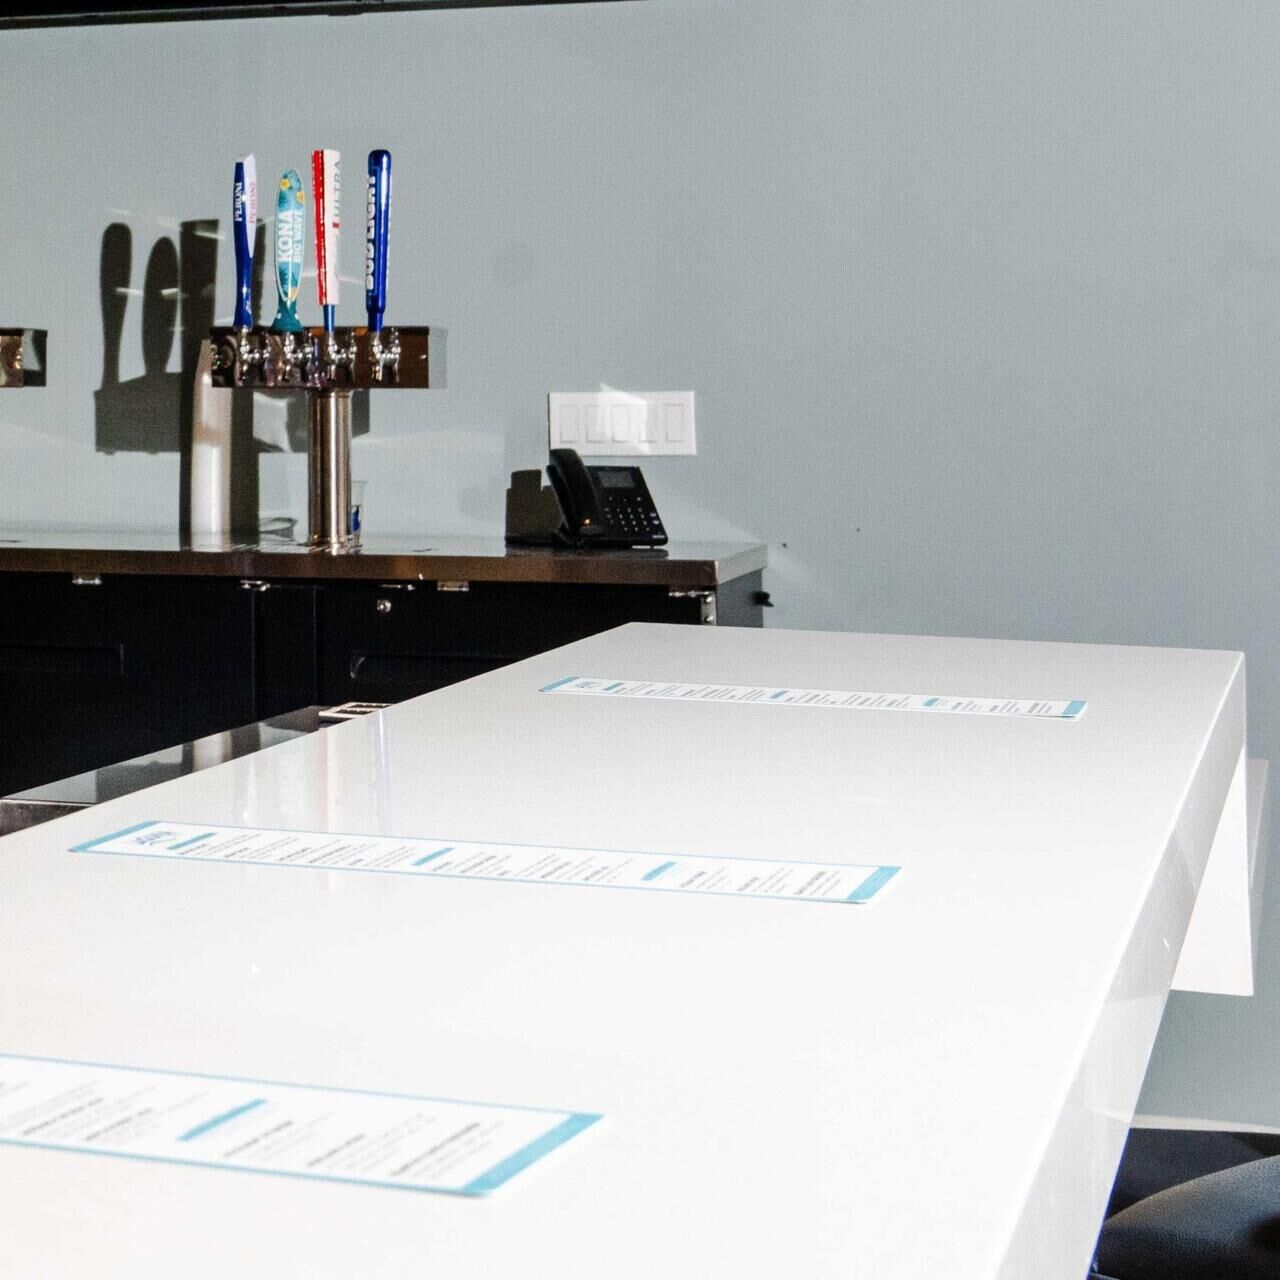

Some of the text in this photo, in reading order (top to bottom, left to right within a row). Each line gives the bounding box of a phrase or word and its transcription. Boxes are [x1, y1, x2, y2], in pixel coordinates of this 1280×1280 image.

[235, 182, 243, 222] PERONI
[249, 182, 257, 224] PERONI
[278, 209, 293, 262] KONA
[293, 209, 303, 262] BIG WAVE
